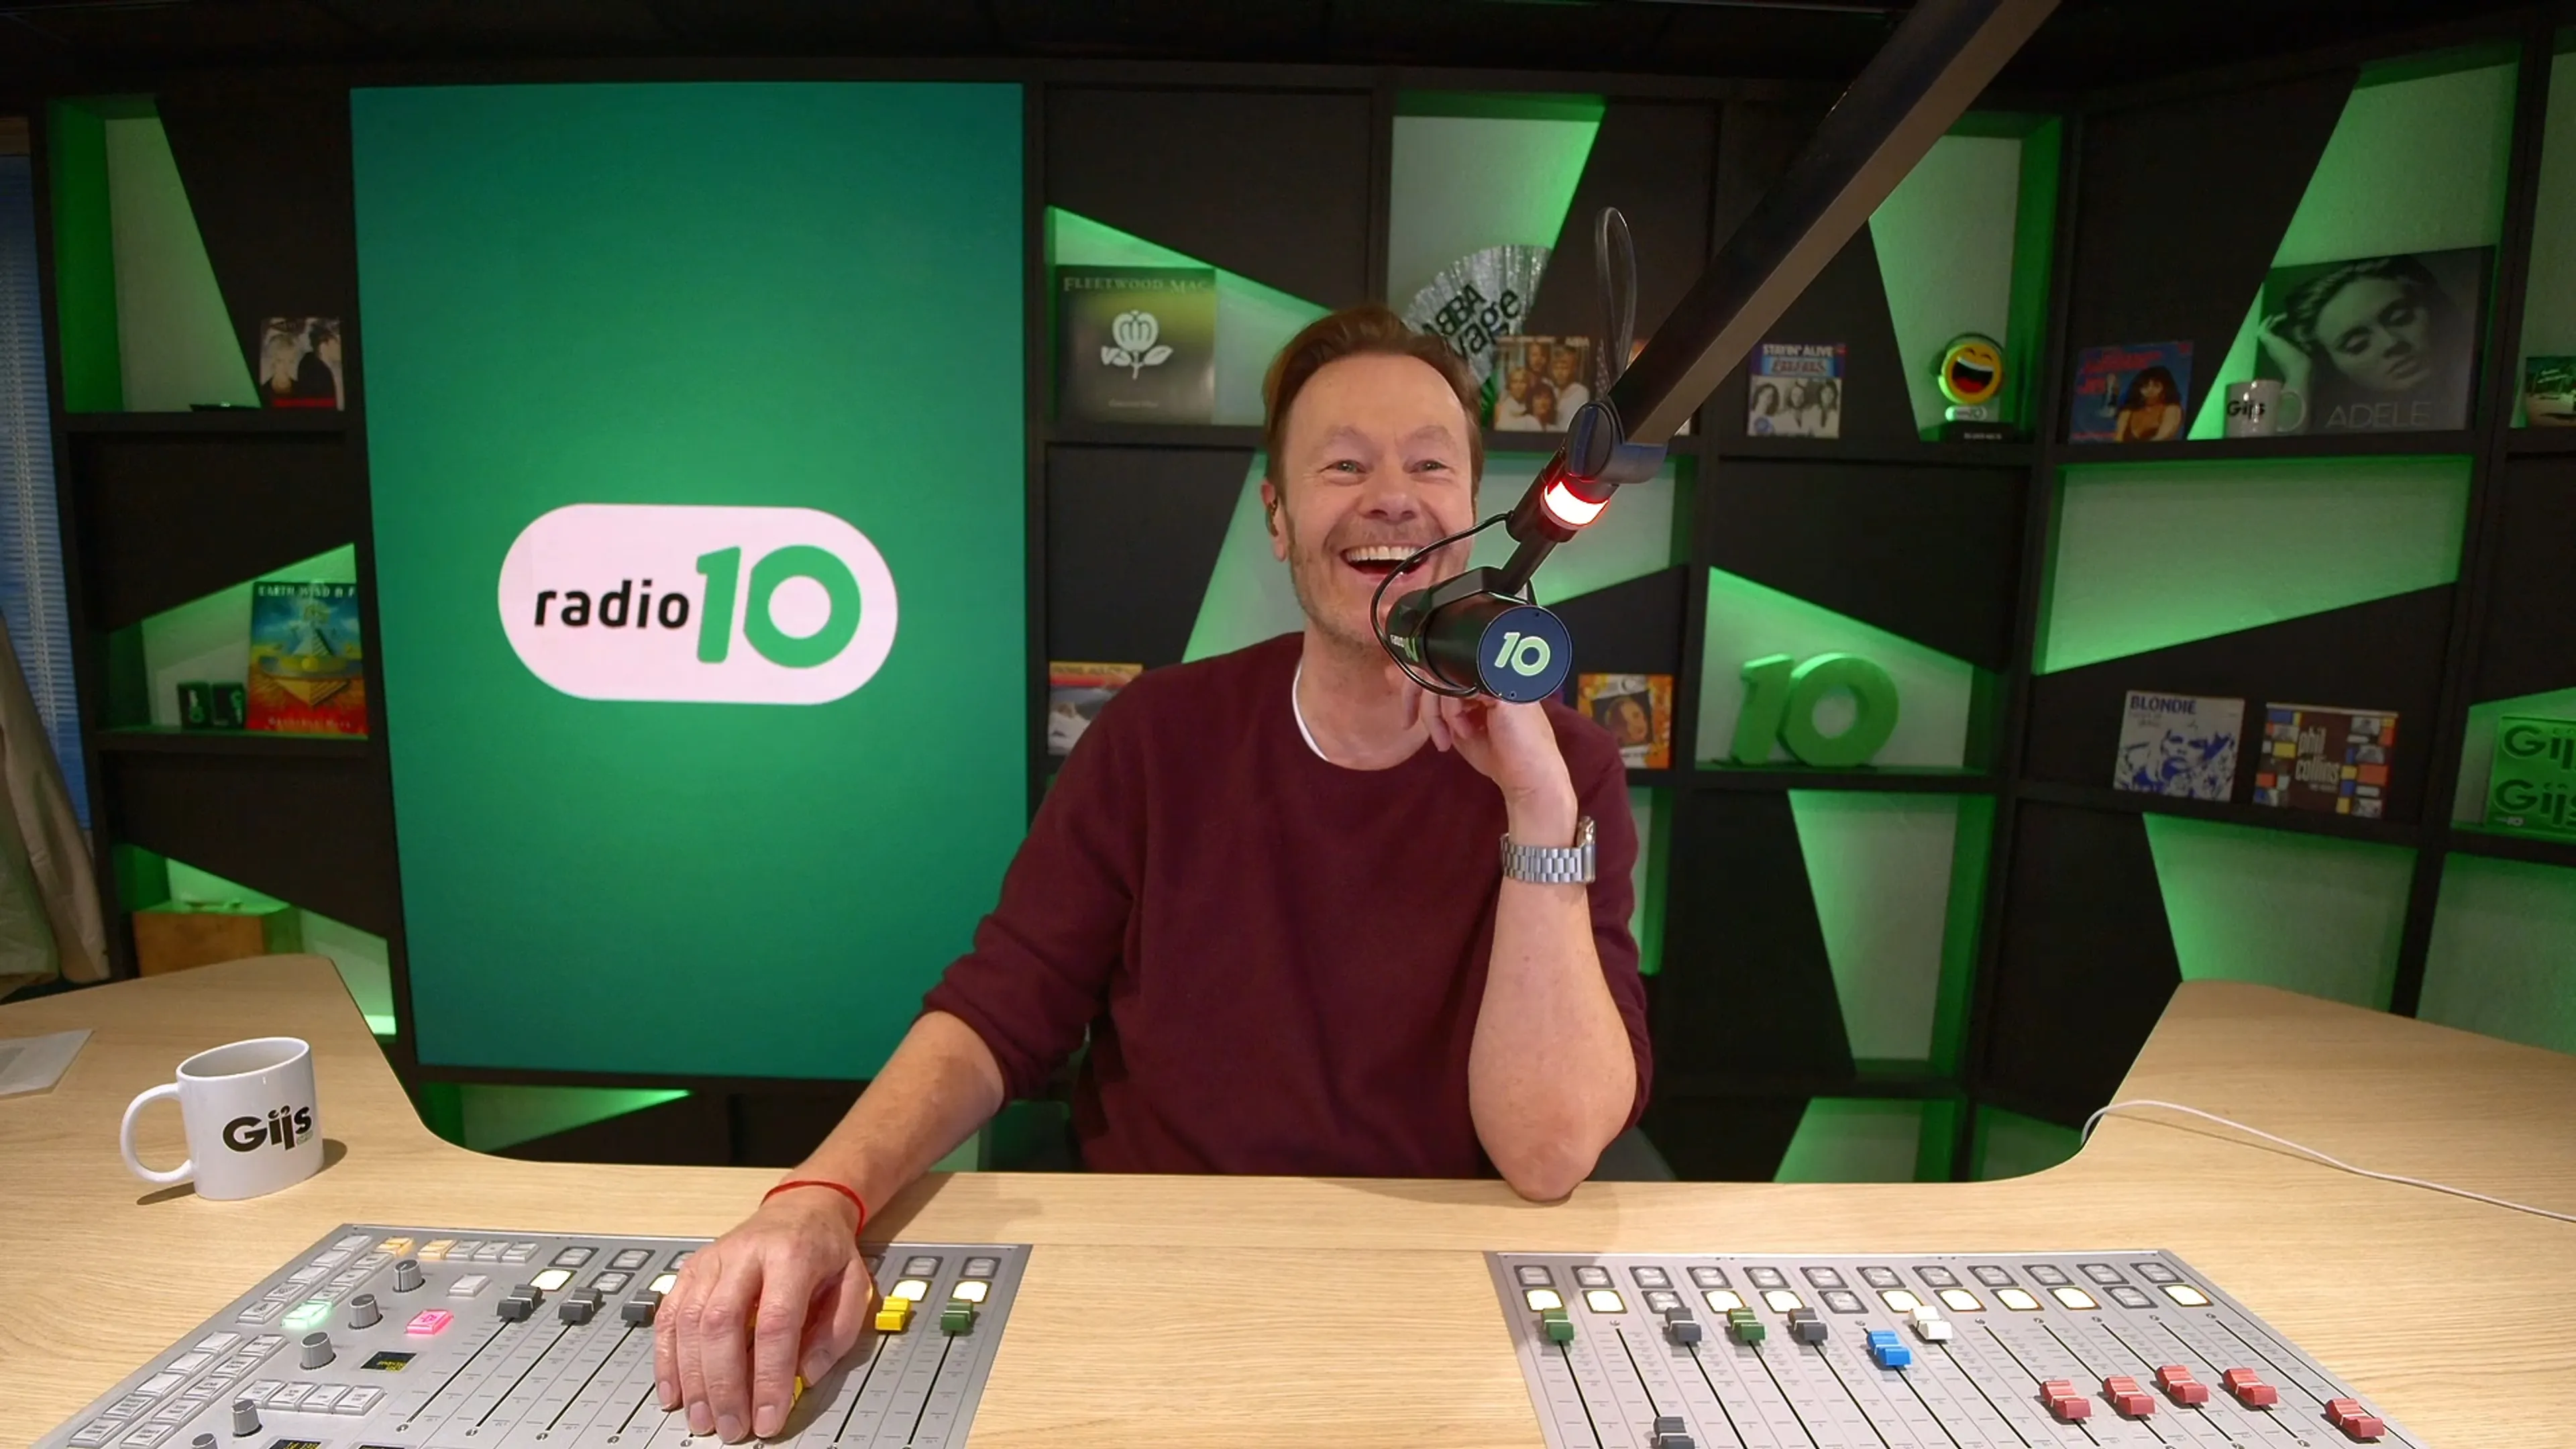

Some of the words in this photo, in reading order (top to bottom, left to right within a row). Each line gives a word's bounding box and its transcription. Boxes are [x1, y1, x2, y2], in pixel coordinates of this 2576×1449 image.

[1063, 276, 1164, 292] FLEETWOOD
[1170, 278, 1209, 294] MAC
[2226, 400, 2264, 420] Gijs
[2324, 401, 2432, 429] ADELE
[1494, 631, 1552, 677] 10
[1730, 652, 1900, 767] 10
[2130, 695, 2197, 715] BLONDIE
[2297, 725, 2327, 757] phil
[2504, 724, 2576, 770] Gij
[2295, 755, 2341, 786] collins
[223, 1105, 312, 1152] Gijs
